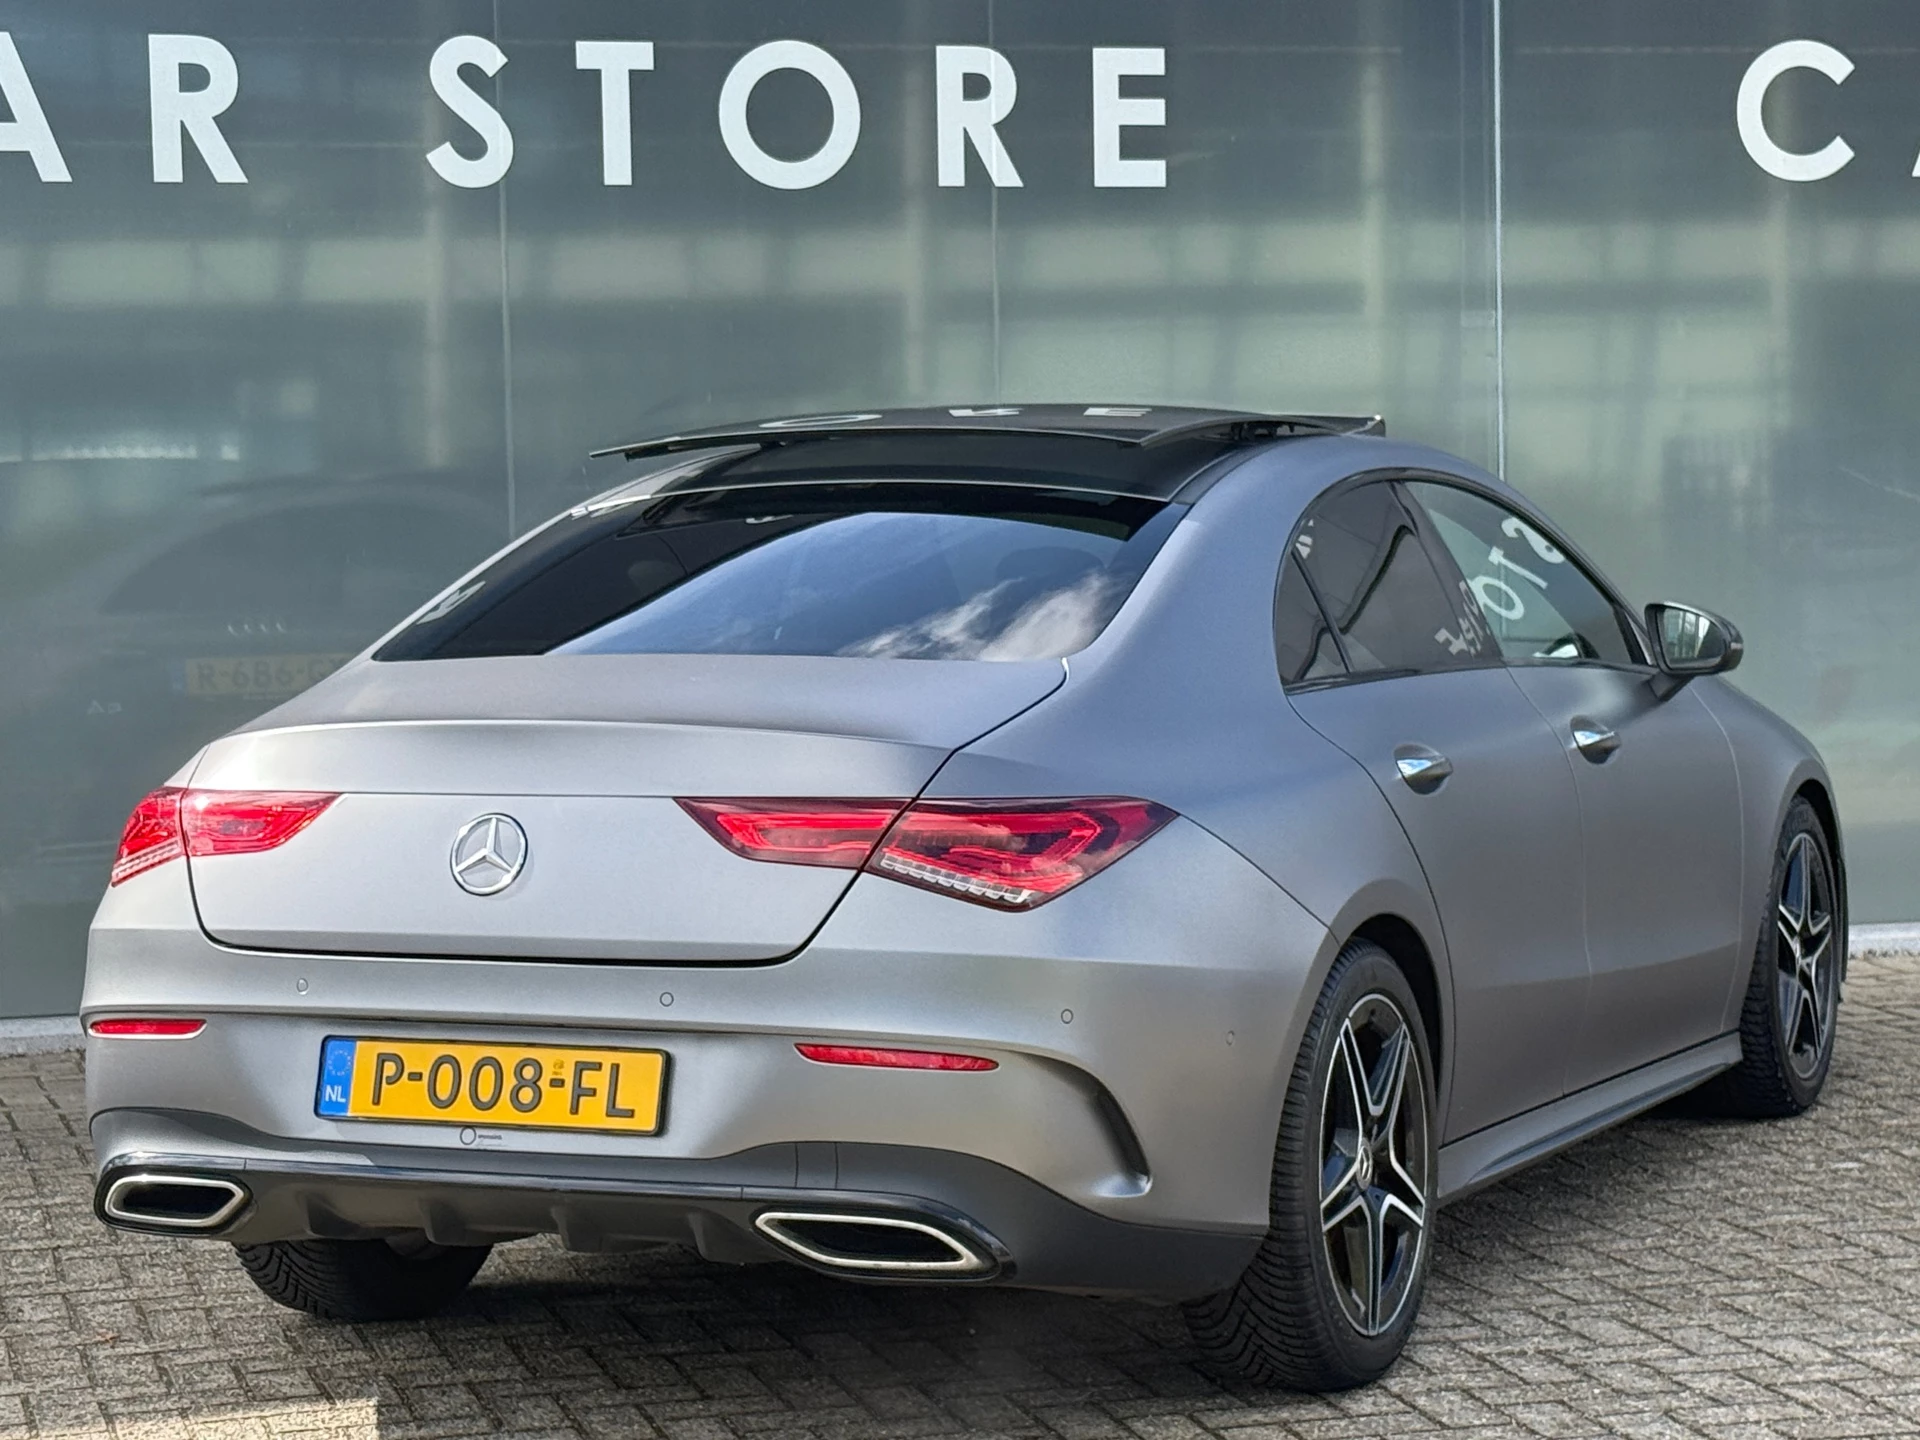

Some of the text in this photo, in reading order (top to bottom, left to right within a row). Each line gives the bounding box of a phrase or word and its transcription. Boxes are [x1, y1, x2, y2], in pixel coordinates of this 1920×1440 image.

[425, 34, 1167, 190] STORE
[1736, 39, 1920, 183] C
[324, 1051, 636, 1119] NL P-008-FL
